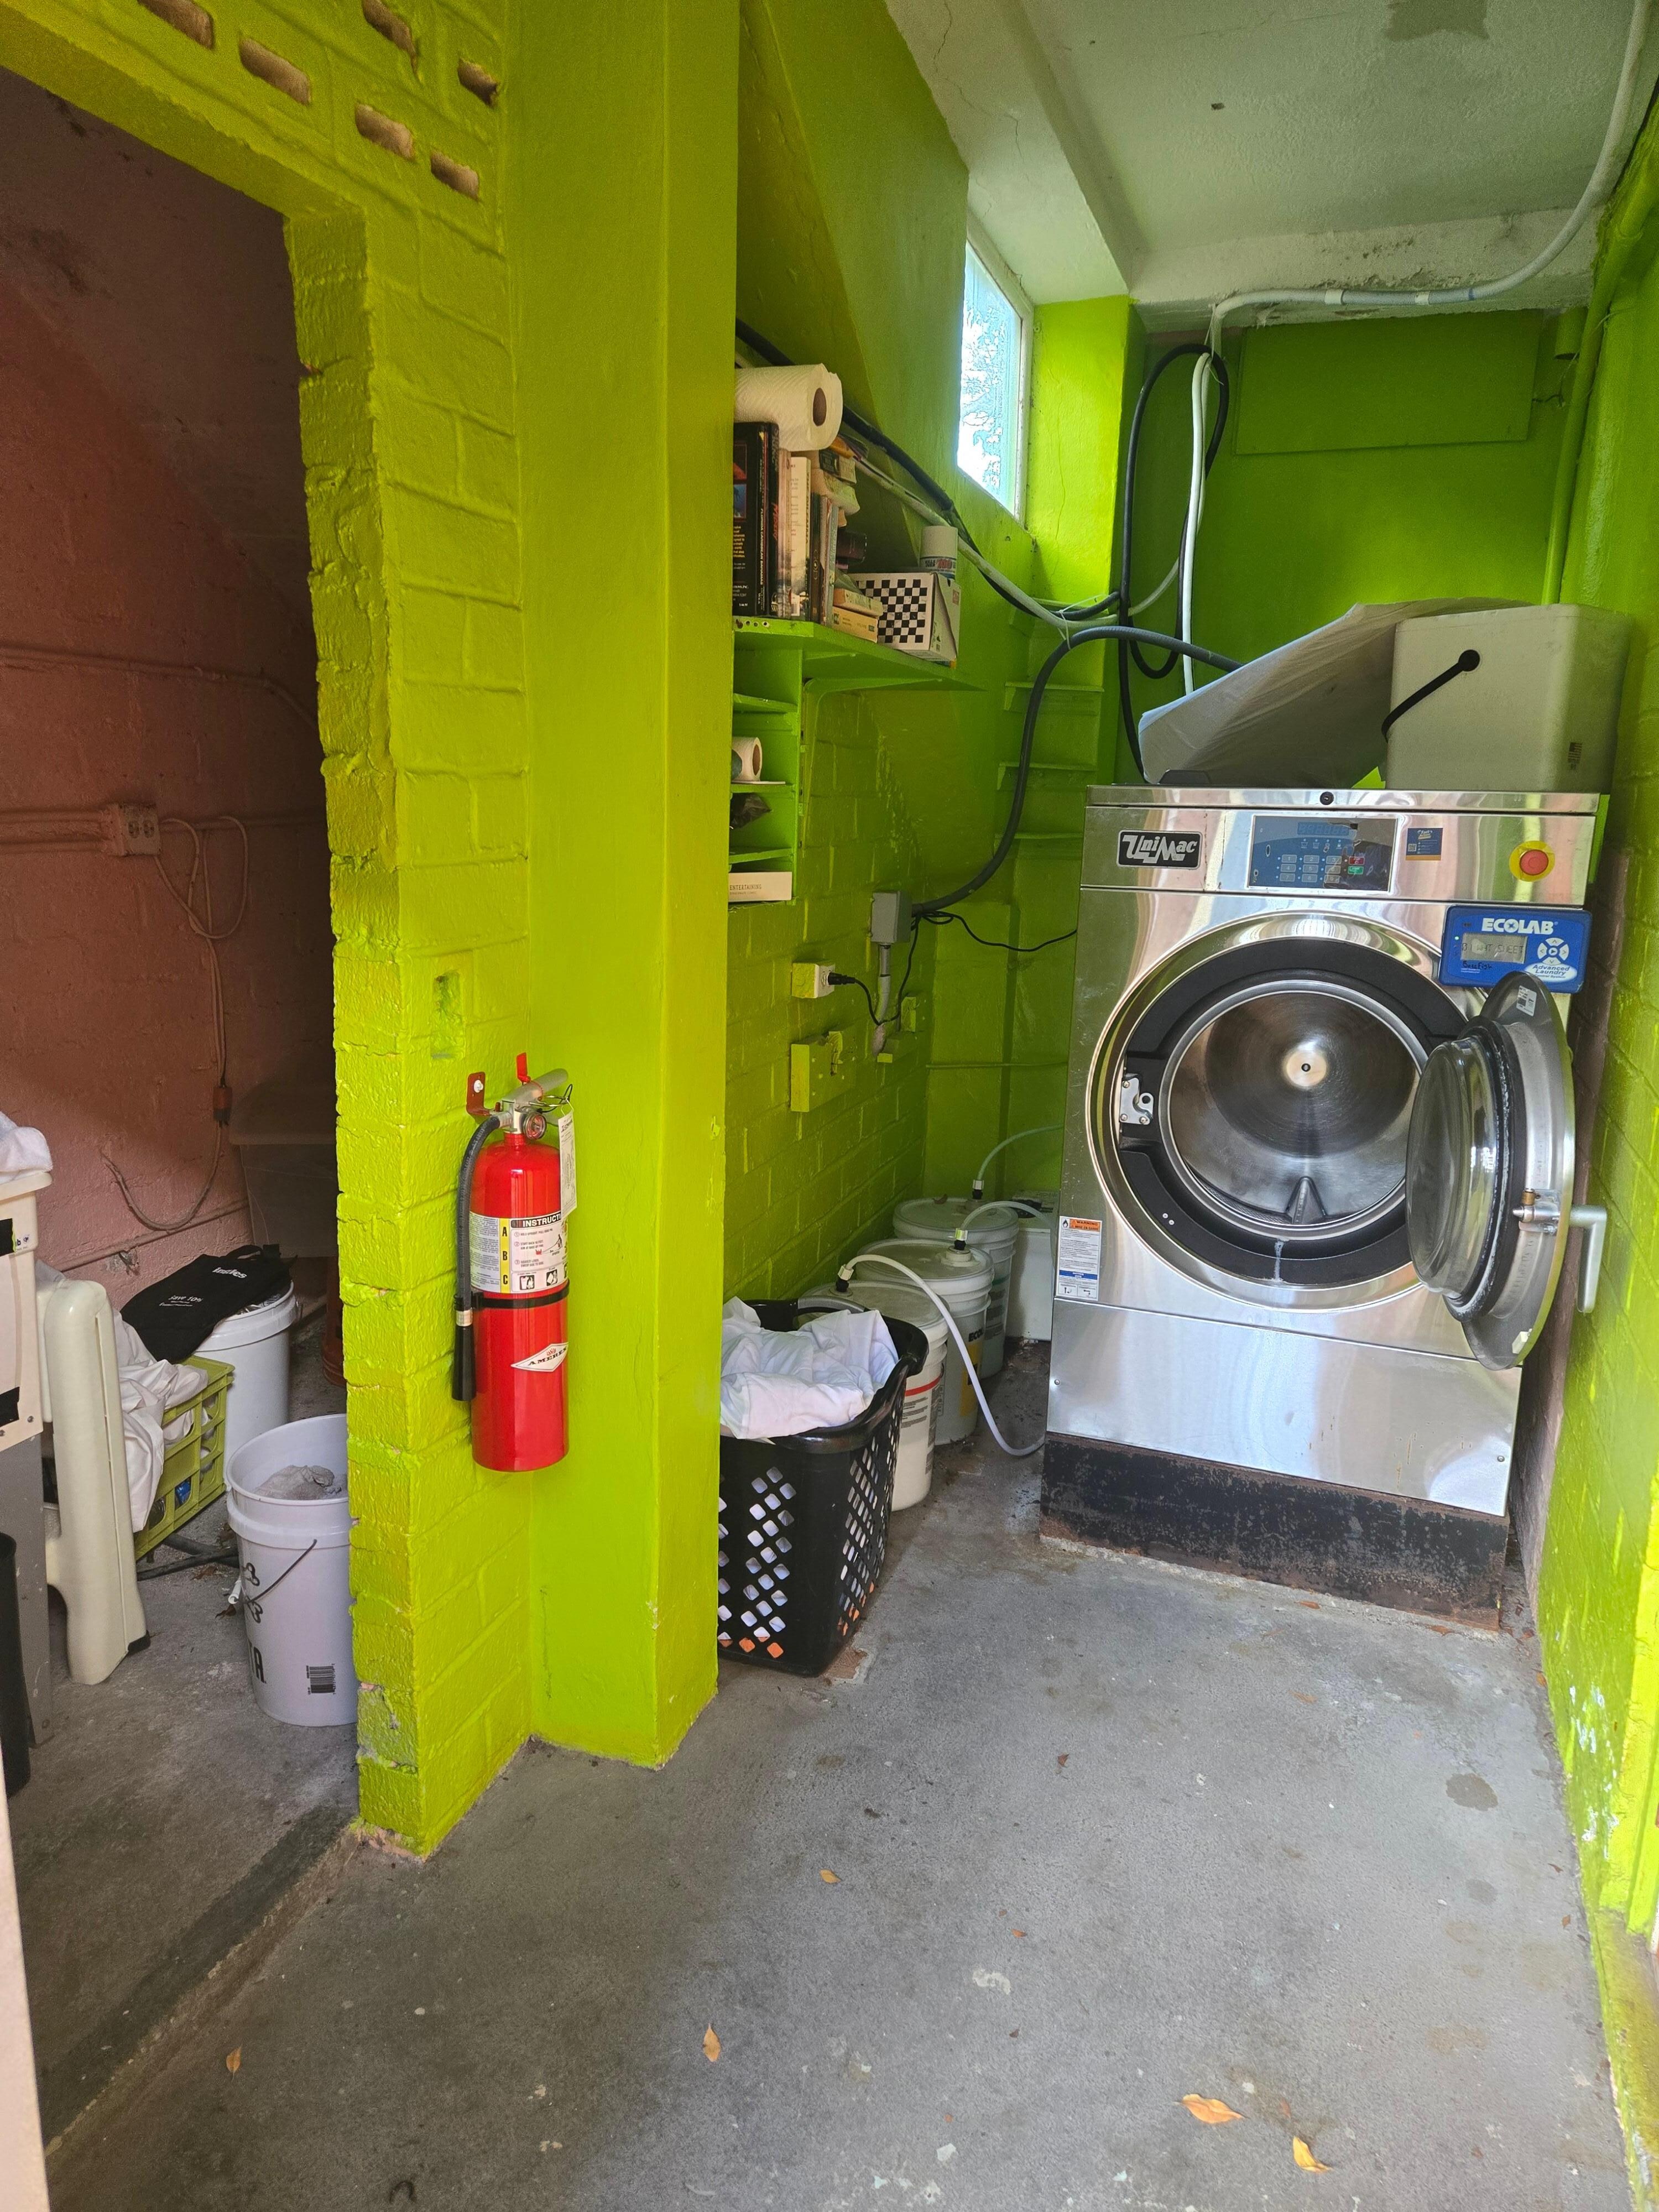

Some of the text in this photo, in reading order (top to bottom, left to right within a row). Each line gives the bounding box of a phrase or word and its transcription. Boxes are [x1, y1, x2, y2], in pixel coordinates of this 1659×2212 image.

[1122, 834, 1197, 864] UniMac
[1481, 918, 1554, 935] ECOLAB
[502, 1227, 508, 1237] A
[503, 1251, 508, 1260] B
[503, 1275, 508, 1284] C
